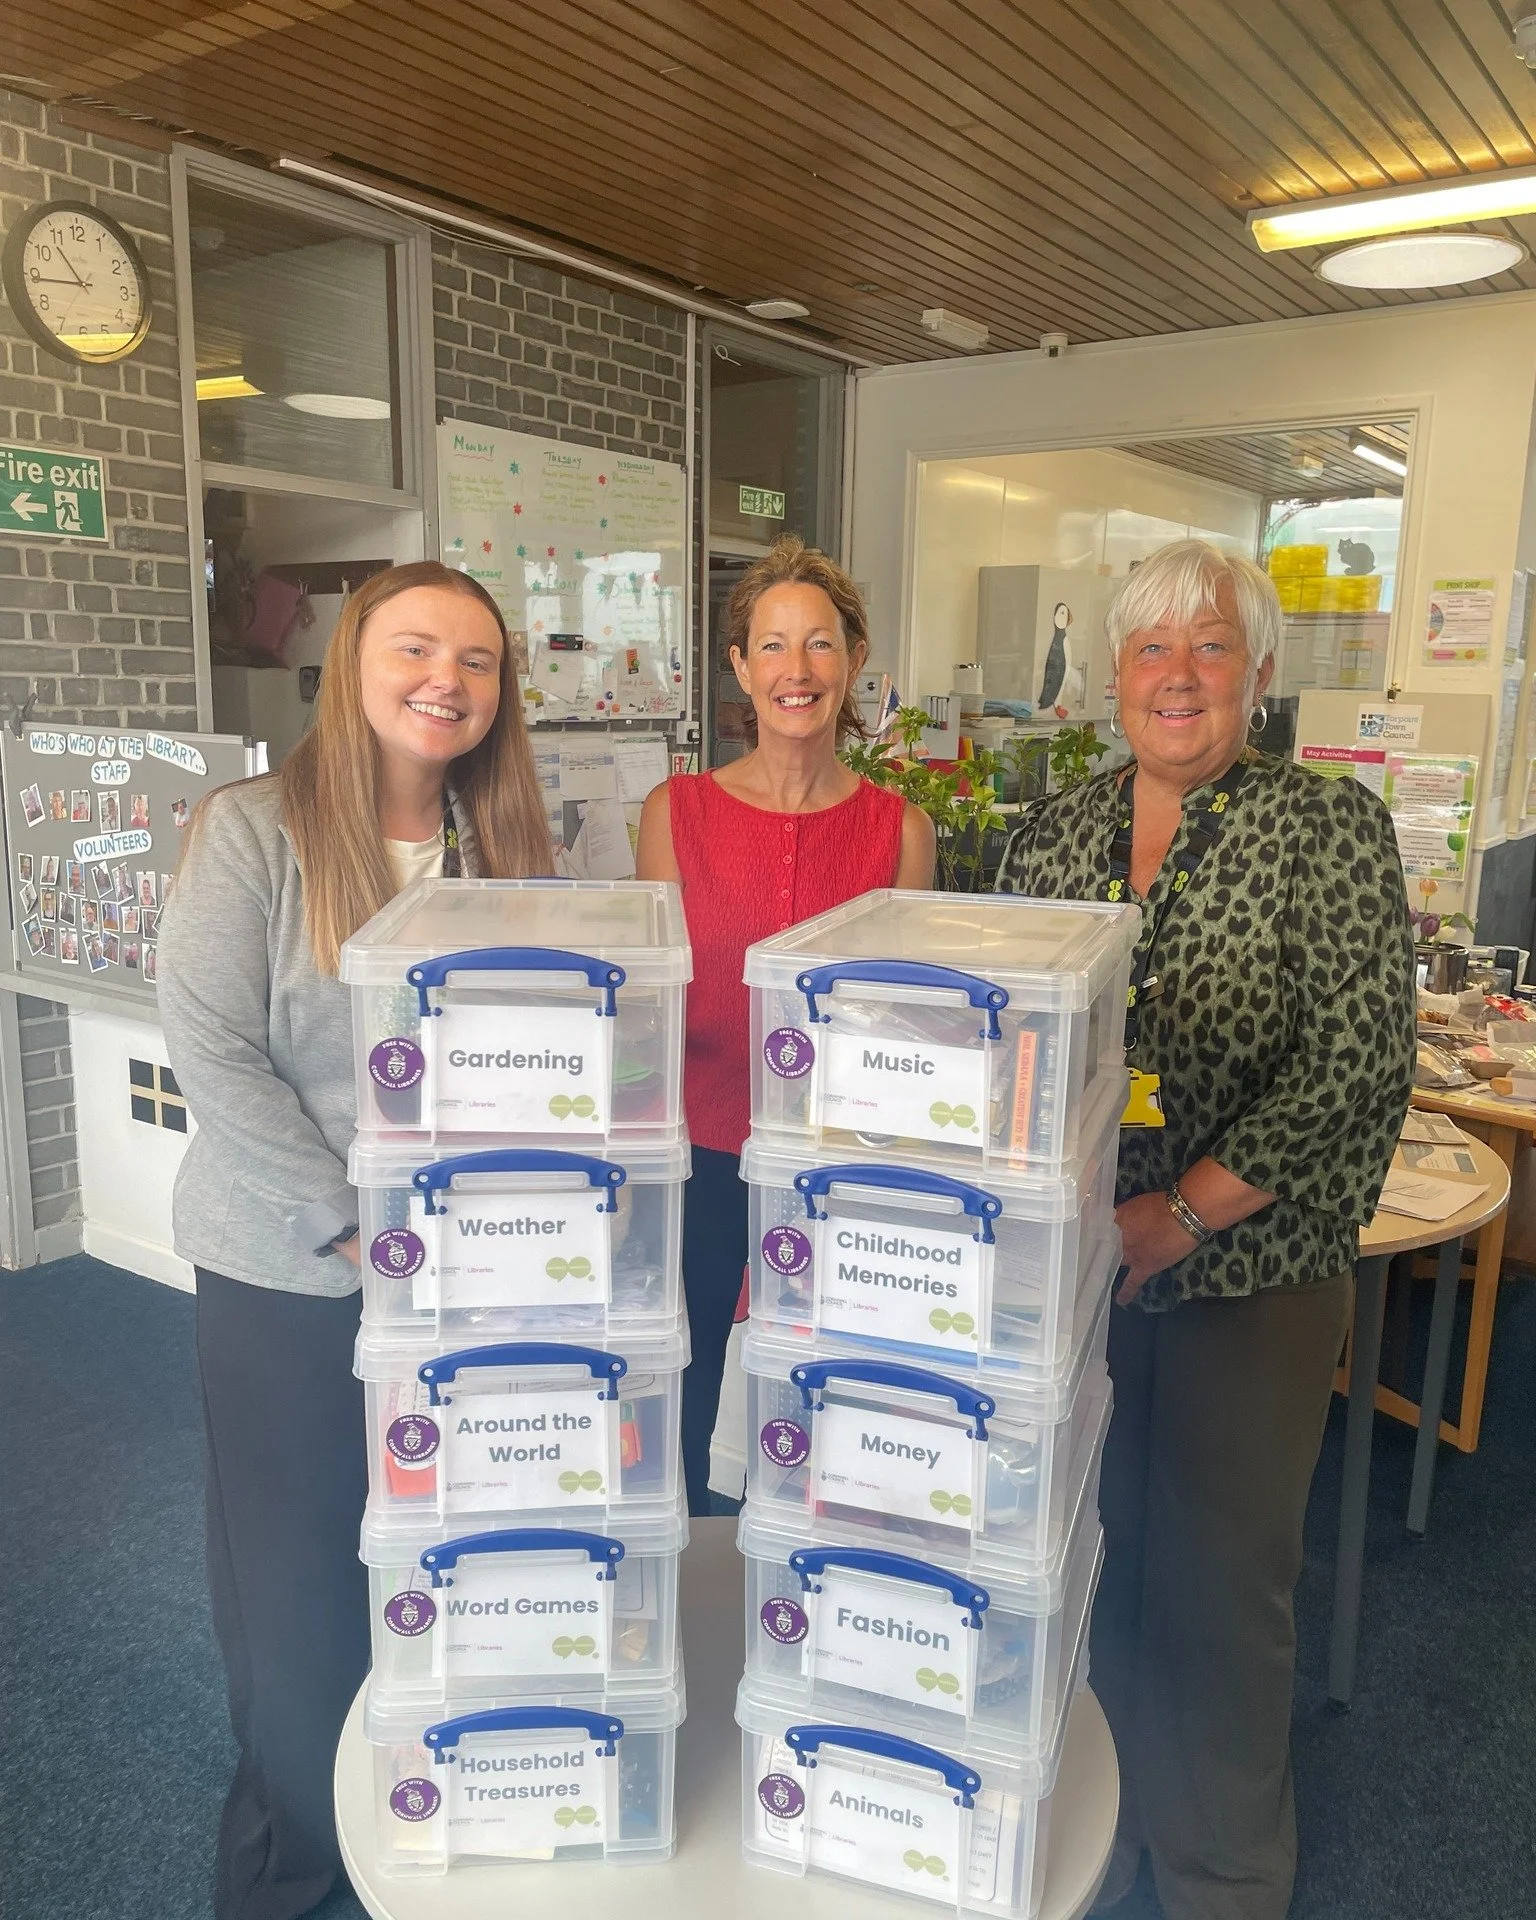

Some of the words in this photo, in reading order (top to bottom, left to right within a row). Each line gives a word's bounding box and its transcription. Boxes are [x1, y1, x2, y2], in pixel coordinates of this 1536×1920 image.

[51, 229, 64, 245] 11
[69, 224, 85, 242] 12
[96, 237, 102, 252] 1
[35, 245, 51, 262] 10
[30, 267, 41, 283] 9
[112, 259, 121, 275] 2
[39, 294, 50, 311] 8
[120, 286, 129, 302] 3
[56, 315, 66, 332] 7
[114, 308, 125, 323] 4
[50, 462, 99, 491] exit
[1384, 714, 1419, 724] Torpoint
[1384, 722, 1406, 730] Town
[1382, 730, 1414, 740] Council
[31, 734, 65, 751] WHO'S
[69, 736, 94, 753] WHO
[100, 738, 115, 752] AT
[120, 738, 142, 756] THE
[1306, 750, 1320, 758] May
[1320, 750, 1352, 759] Activities
[94, 763, 128, 781] STAFF
[75, 831, 150, 858] VOLUNTEERS
[382, 1040, 398, 1049] FREE
[399, 1040, 414, 1052] WITH
[794, 1031, 808, 1044] WITH
[449, 1050, 583, 1076] Gardening
[766, 1048, 785, 1076] CORNWALL
[862, 1049, 936, 1076] Music
[371, 1064, 396, 1088] CORNWALL
[458, 1217, 566, 1237] Weather
[772, 1228, 786, 1236] FREE
[788, 1229, 801, 1240] WITH
[378, 1232, 391, 1244] FREE
[836, 1230, 962, 1266] Childhood
[374, 1261, 404, 1277] CORNWALL
[838, 1262, 958, 1298] Memories
[415, 1416, 430, 1426] WITH
[456, 1414, 546, 1435] Around
[552, 1412, 592, 1430] the
[787, 1422, 801, 1434] WITH
[488, 1443, 561, 1463] World
[860, 1432, 942, 1470] Money
[394, 1594, 408, 1602] FREE
[410, 1593, 425, 1601] WITH
[784, 1600, 799, 1611] WITH
[447, 1598, 509, 1616] Word
[515, 1598, 599, 1614] Games
[836, 1606, 950, 1651] Fashion
[460, 1750, 584, 1774] Household
[464, 1782, 581, 1802] Treasures
[829, 1790, 924, 1829] Animals
